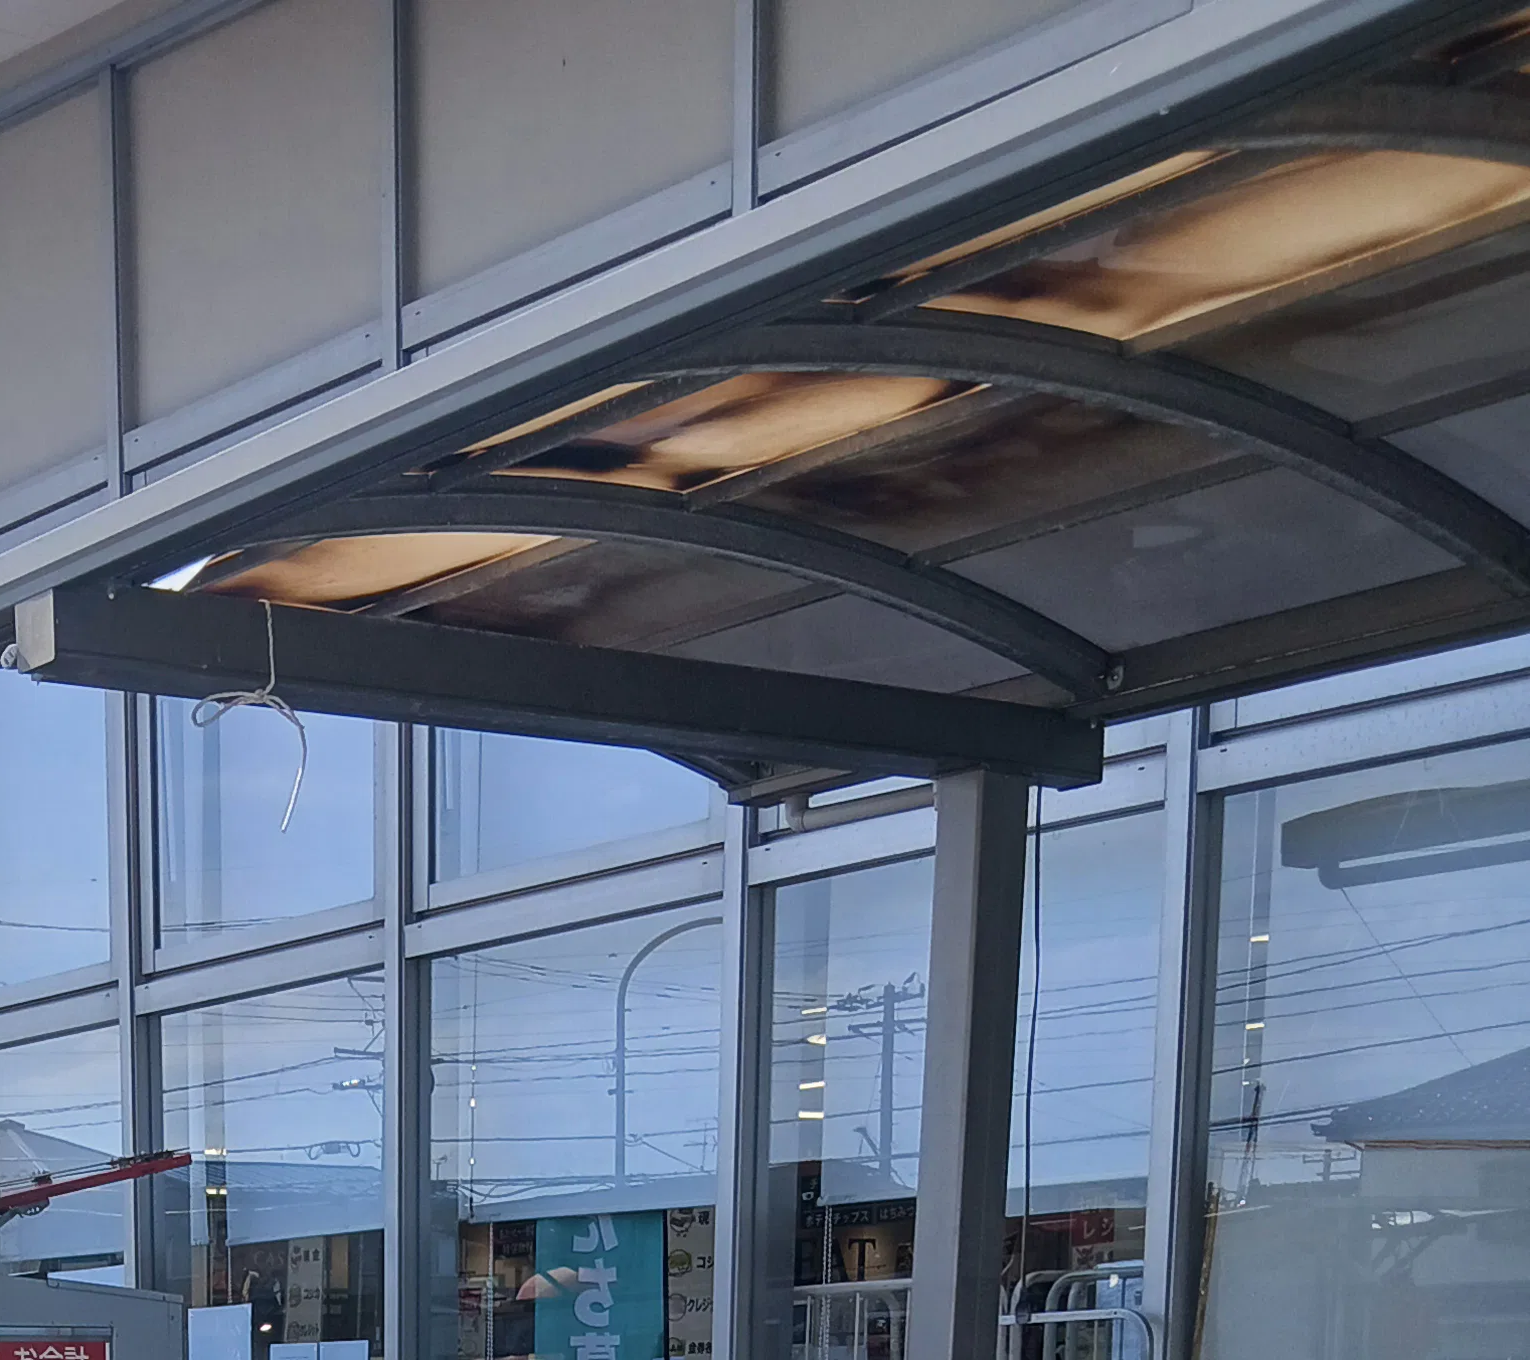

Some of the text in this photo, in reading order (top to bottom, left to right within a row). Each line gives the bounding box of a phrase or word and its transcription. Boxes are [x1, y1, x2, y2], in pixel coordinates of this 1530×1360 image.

[805, 1210, 870, 1228] ポテチップス
